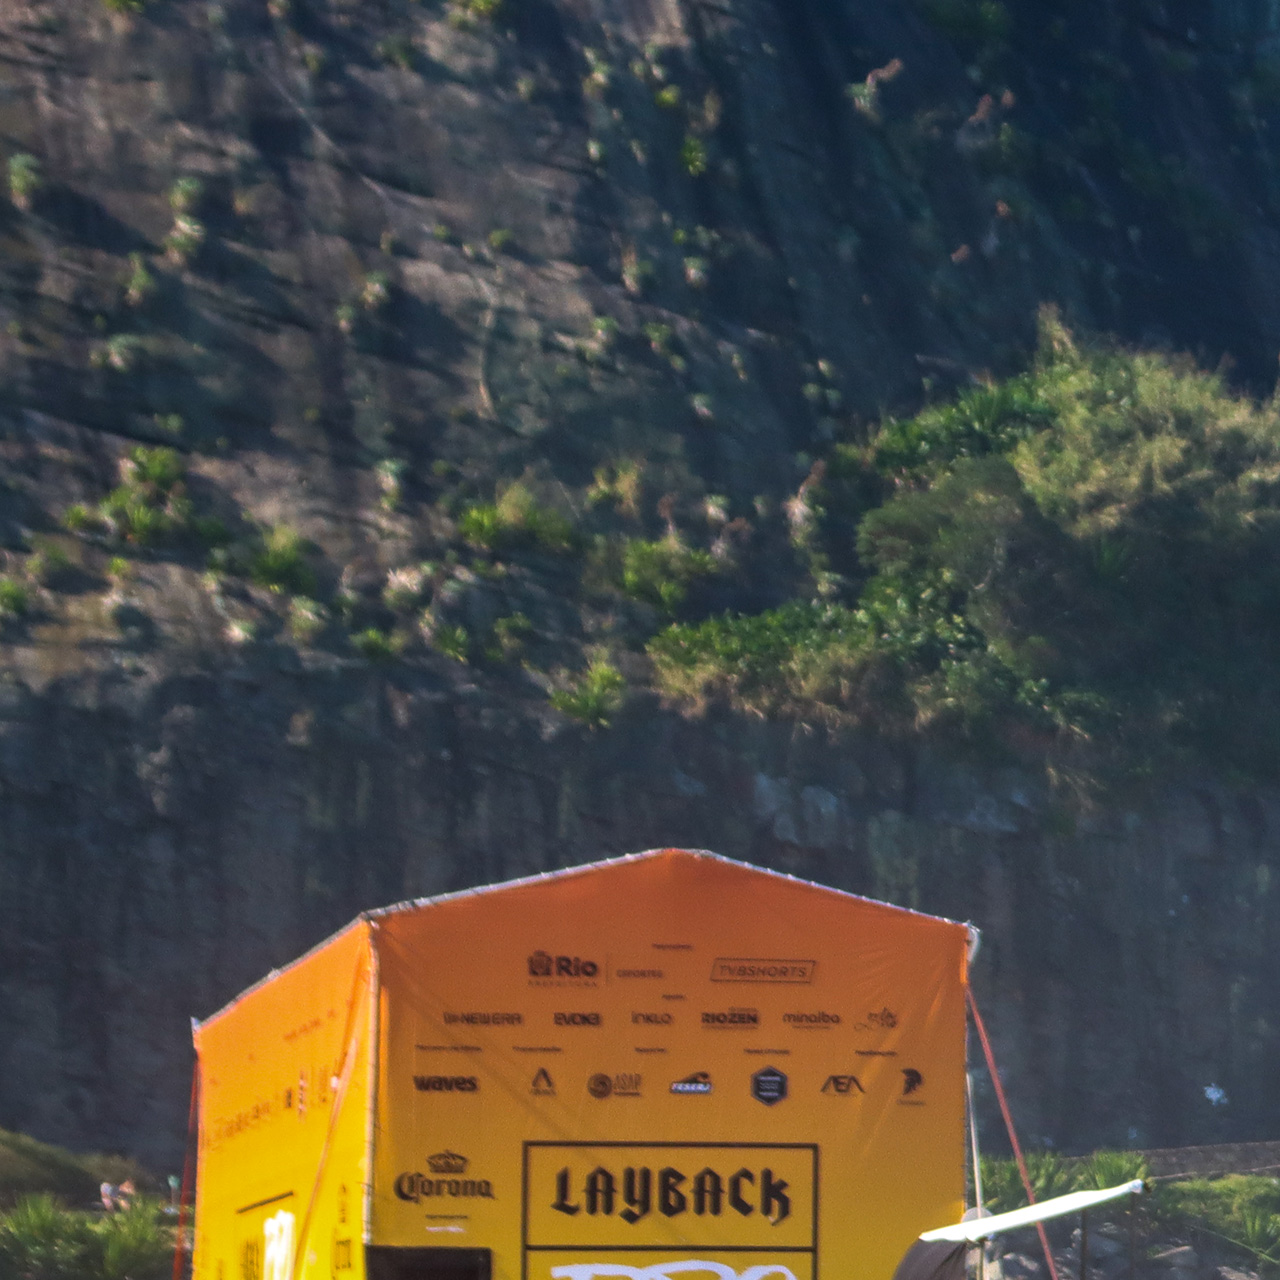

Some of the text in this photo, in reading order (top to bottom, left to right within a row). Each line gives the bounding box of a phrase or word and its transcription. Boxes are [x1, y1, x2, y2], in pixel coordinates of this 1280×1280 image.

[555, 956, 598, 977] Rio
[702, 1012, 759, 1024] RIOZEN
[413, 1075, 479, 1092] waves
[394, 1172, 497, 1203] Corona
[550, 1166, 790, 1226] LAYBACK
